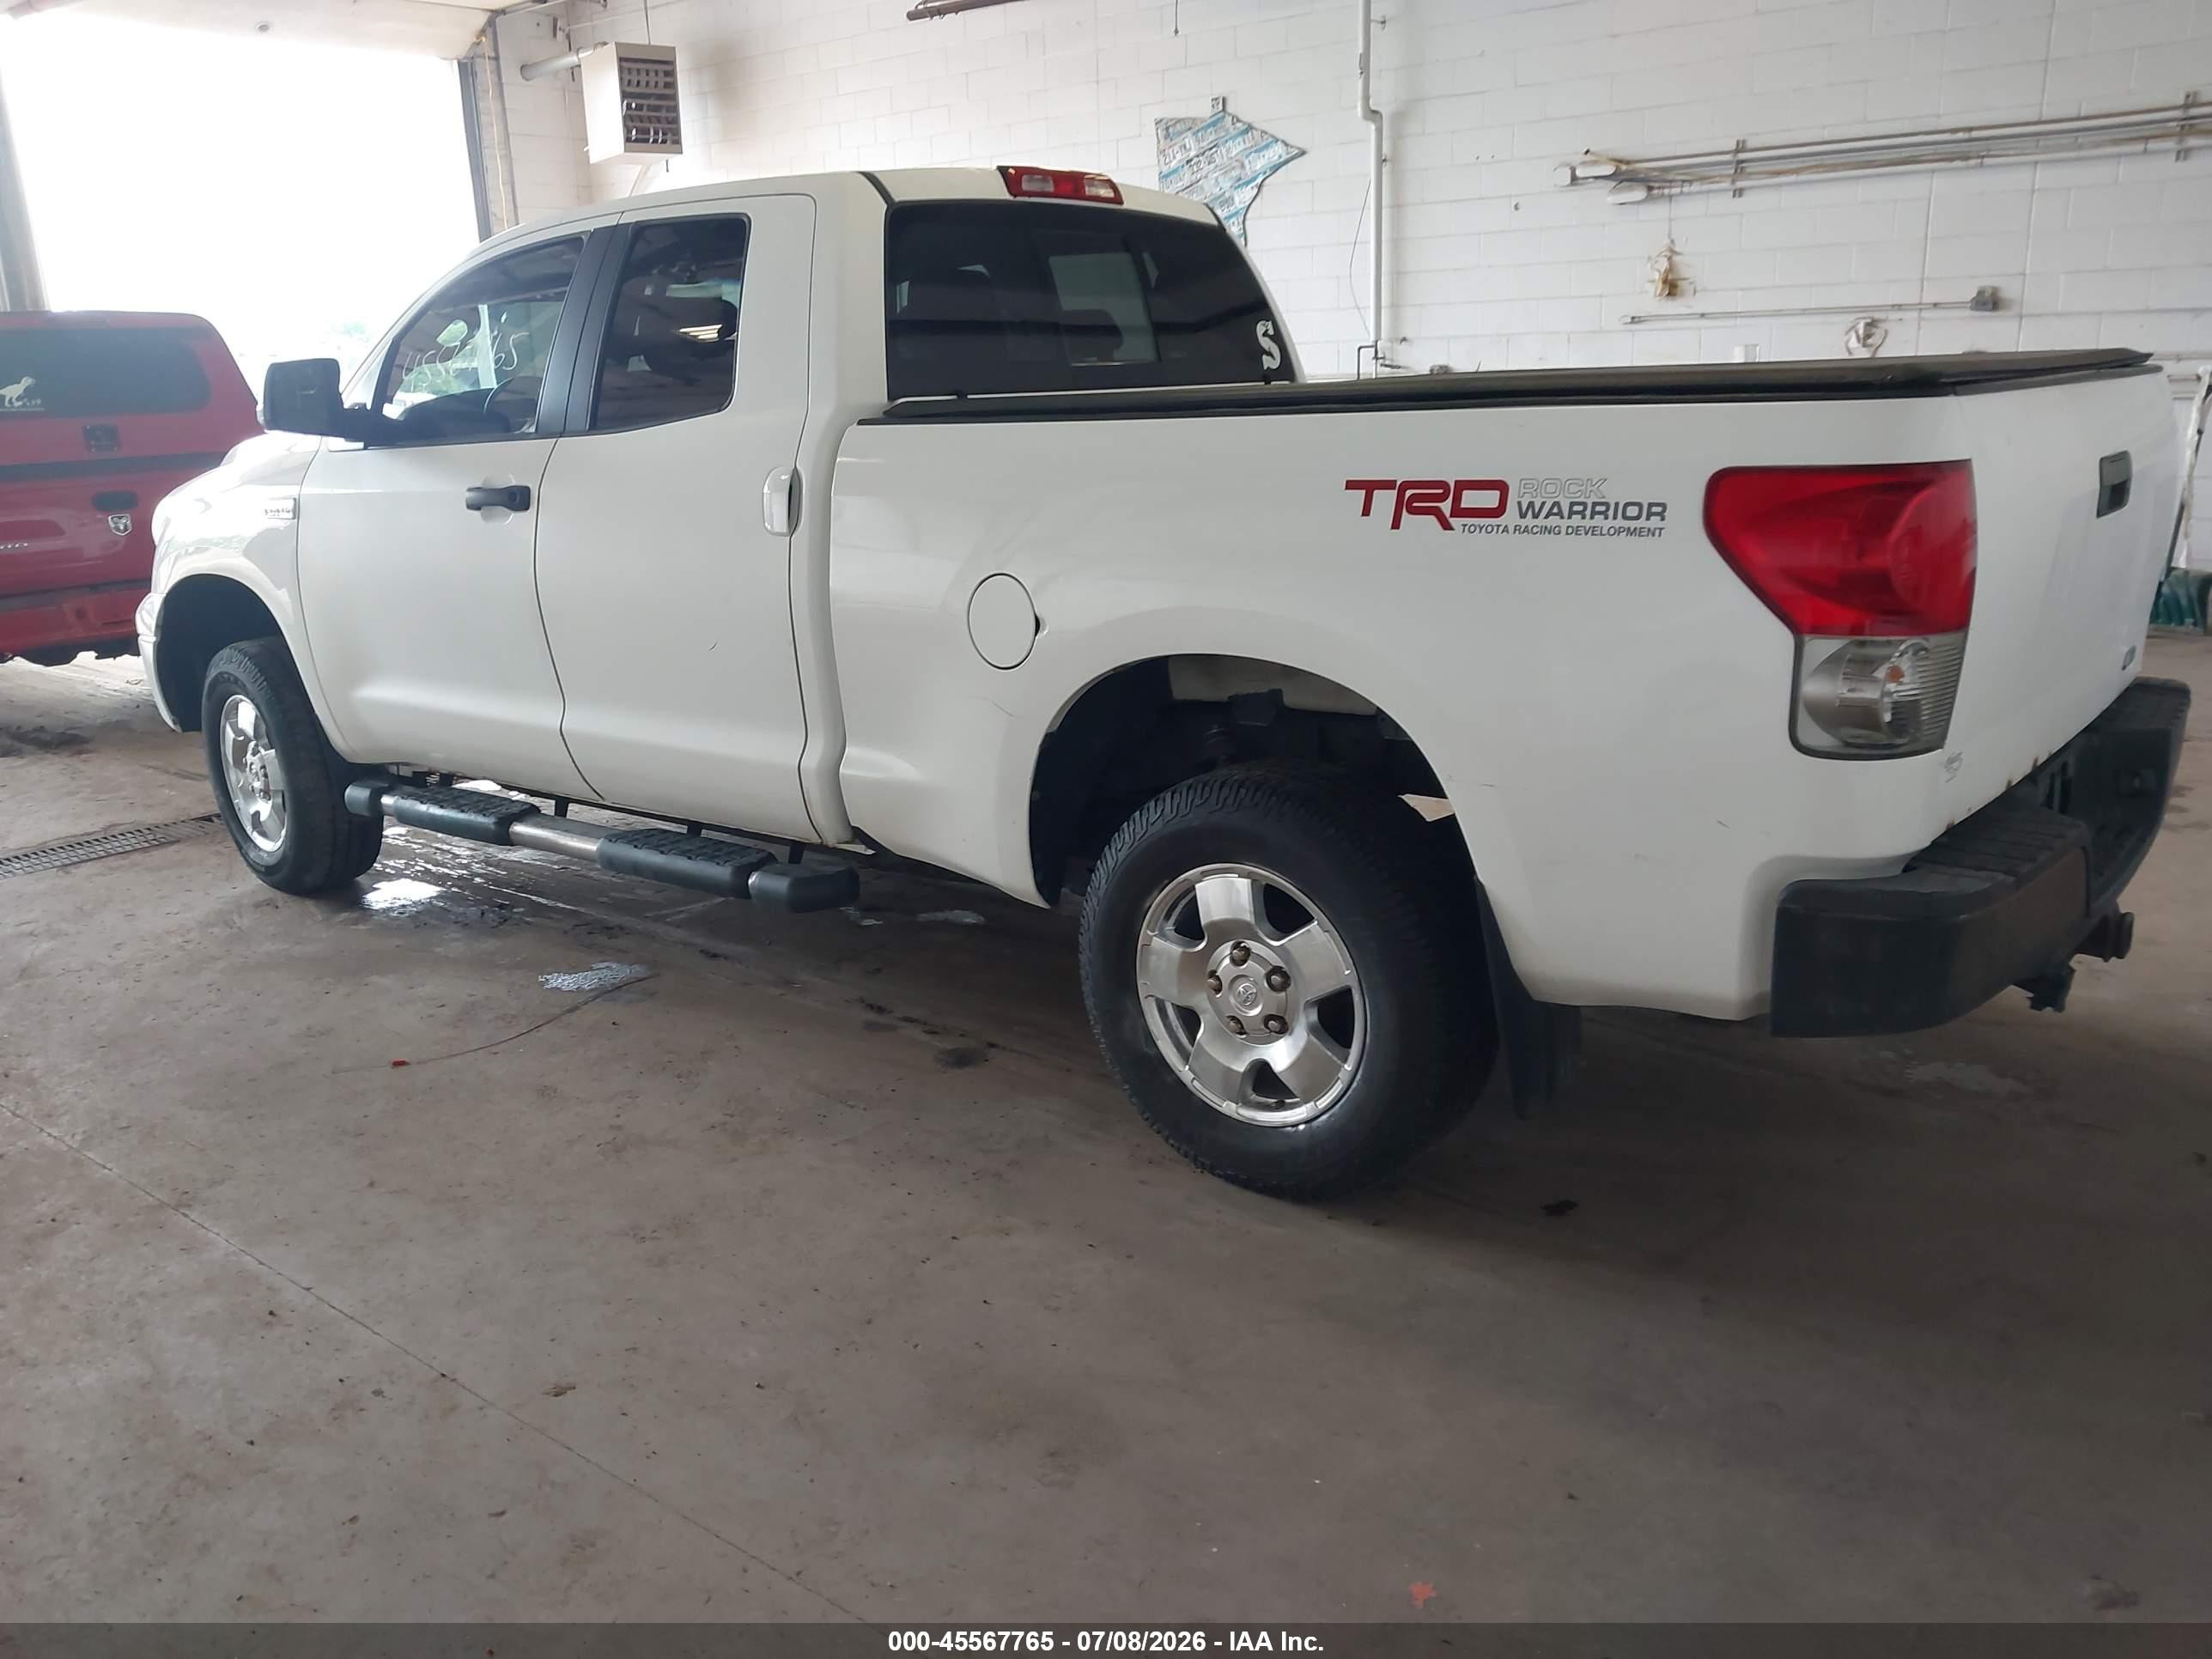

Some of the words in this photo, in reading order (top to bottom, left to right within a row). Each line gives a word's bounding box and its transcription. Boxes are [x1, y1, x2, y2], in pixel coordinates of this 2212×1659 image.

[1516, 477, 1608, 500] ROCK
[1344, 478, 1510, 532] TRD
[1516, 501, 1668, 522] WARRIOR
[1461, 524, 1510, 535] TOYOTA
[1513, 524, 1562, 537] RACING
[1565, 525, 1666, 538] DEVELOPMENT
